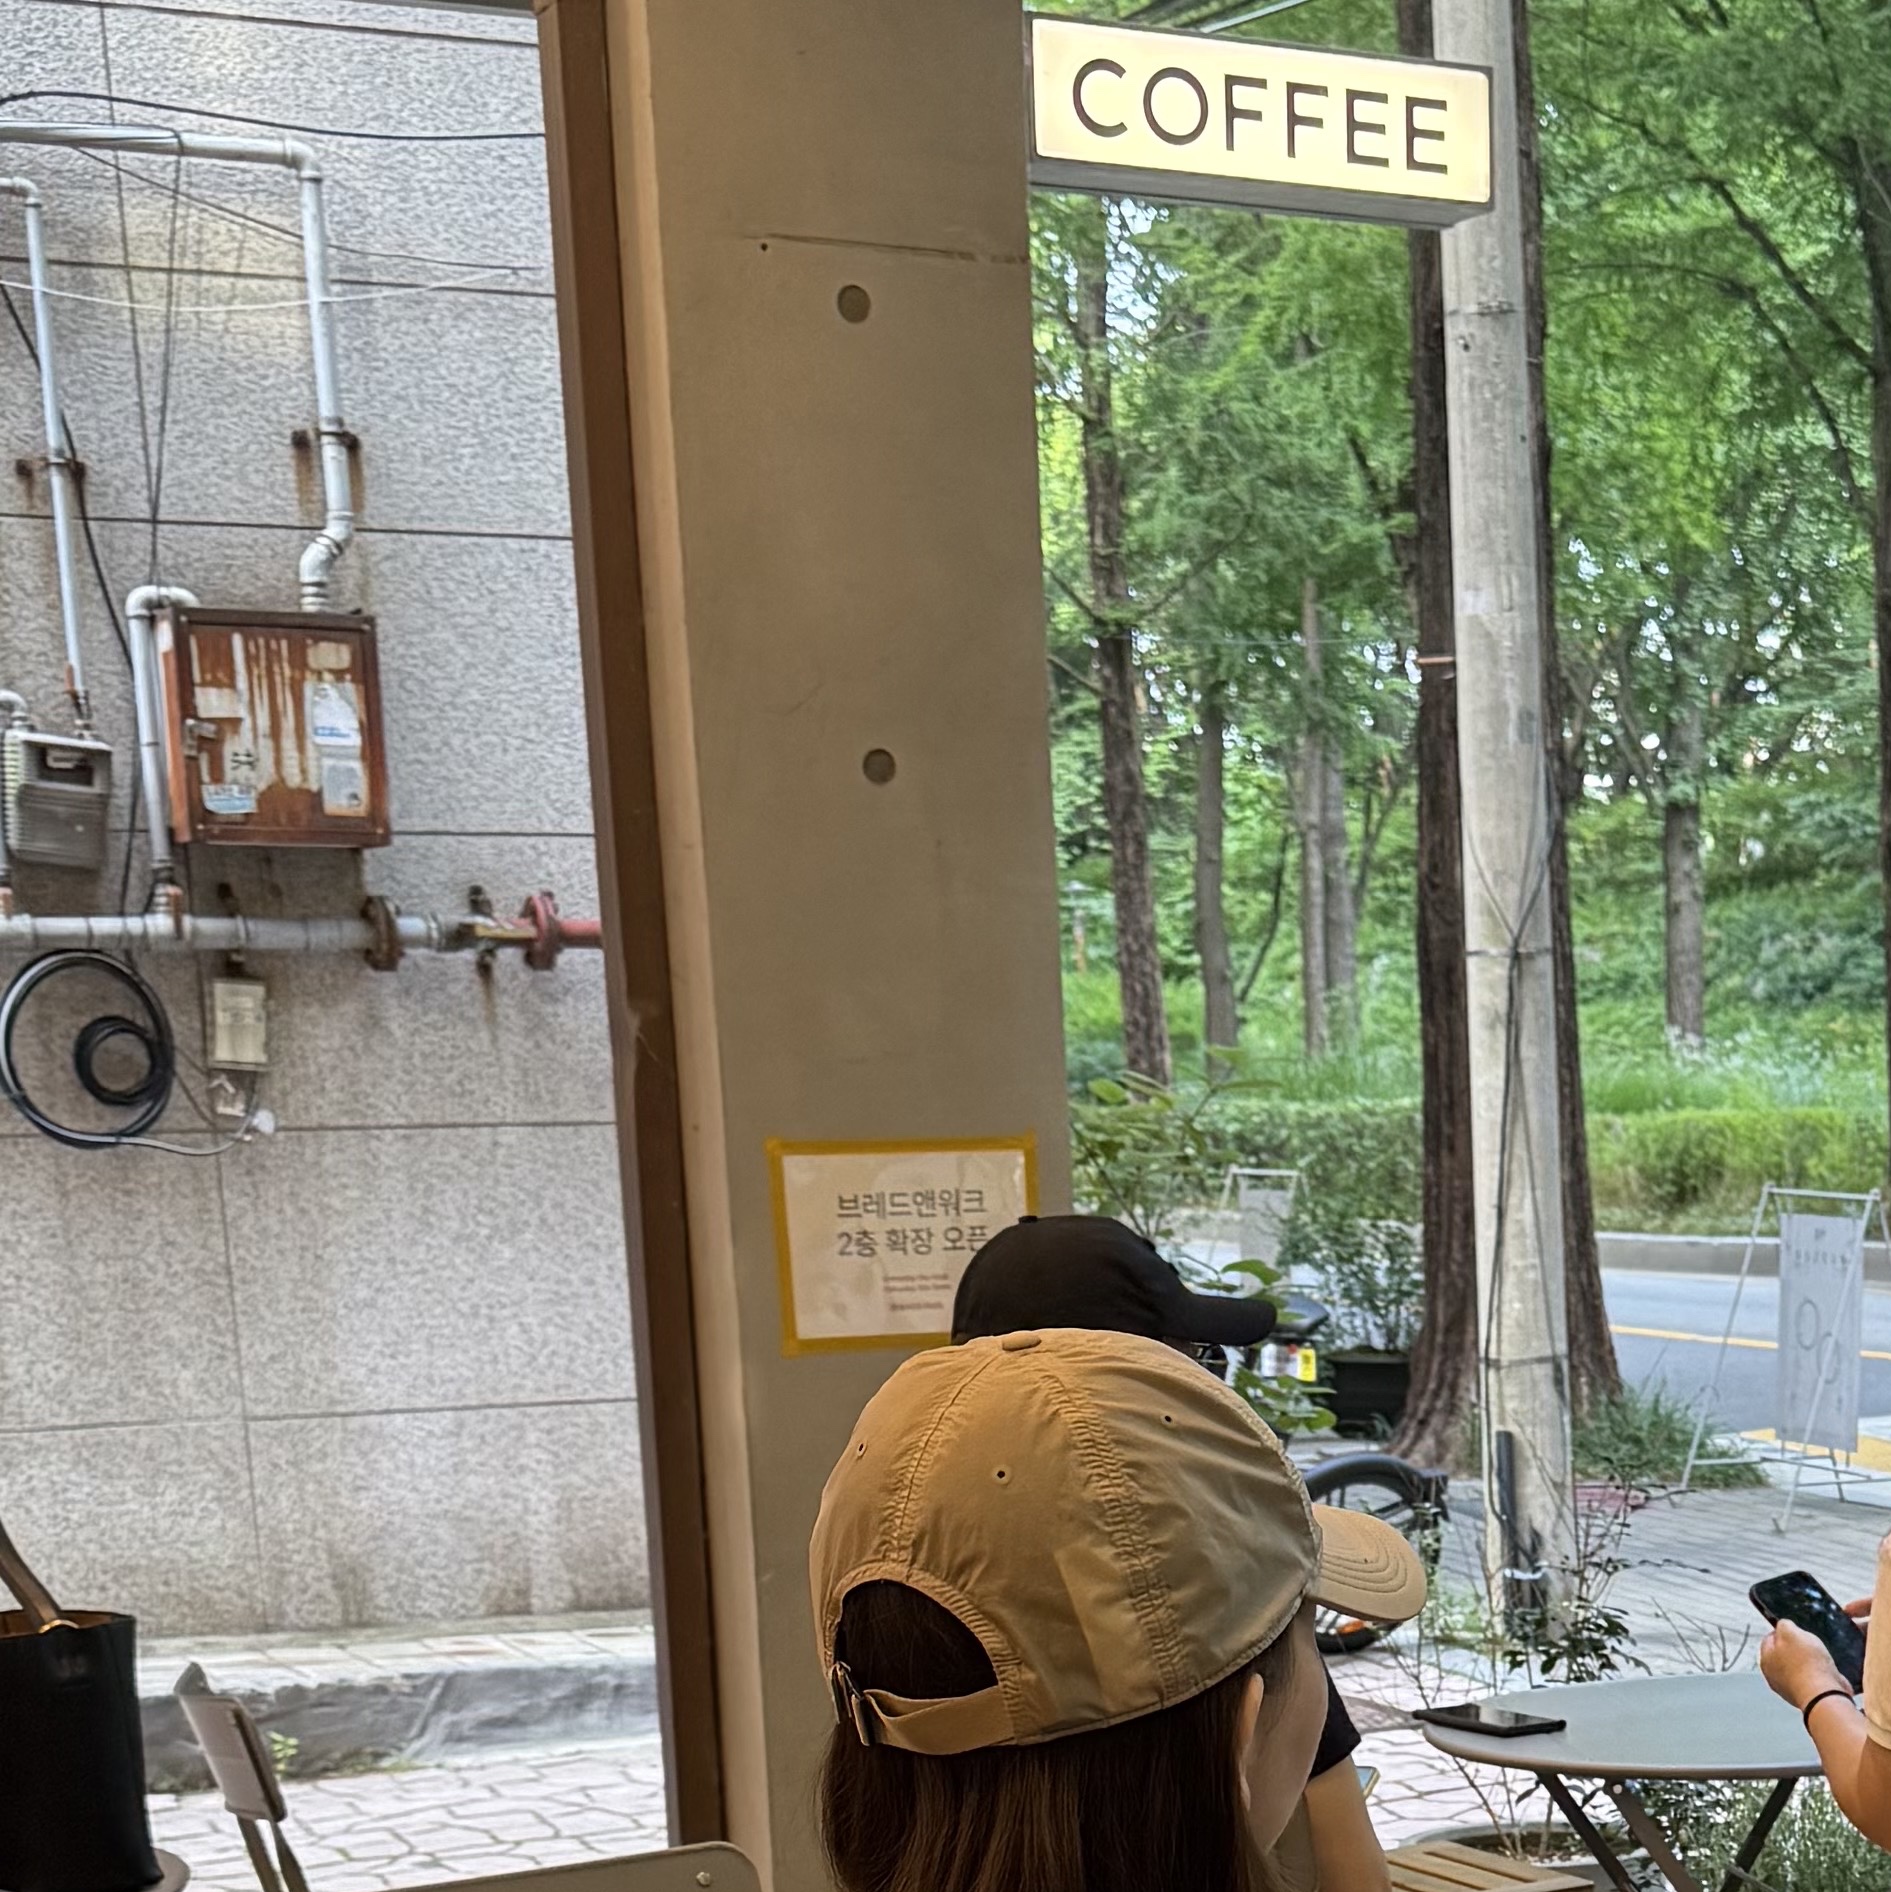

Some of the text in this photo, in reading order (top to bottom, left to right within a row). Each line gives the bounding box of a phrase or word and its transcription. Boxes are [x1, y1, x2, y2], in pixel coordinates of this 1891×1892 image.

[1072, 57, 1448, 175] COFFEE
[837, 1189, 988, 1220] 브레드앤워크
[837, 1225, 989, 1257] 2층 확장 오픈
